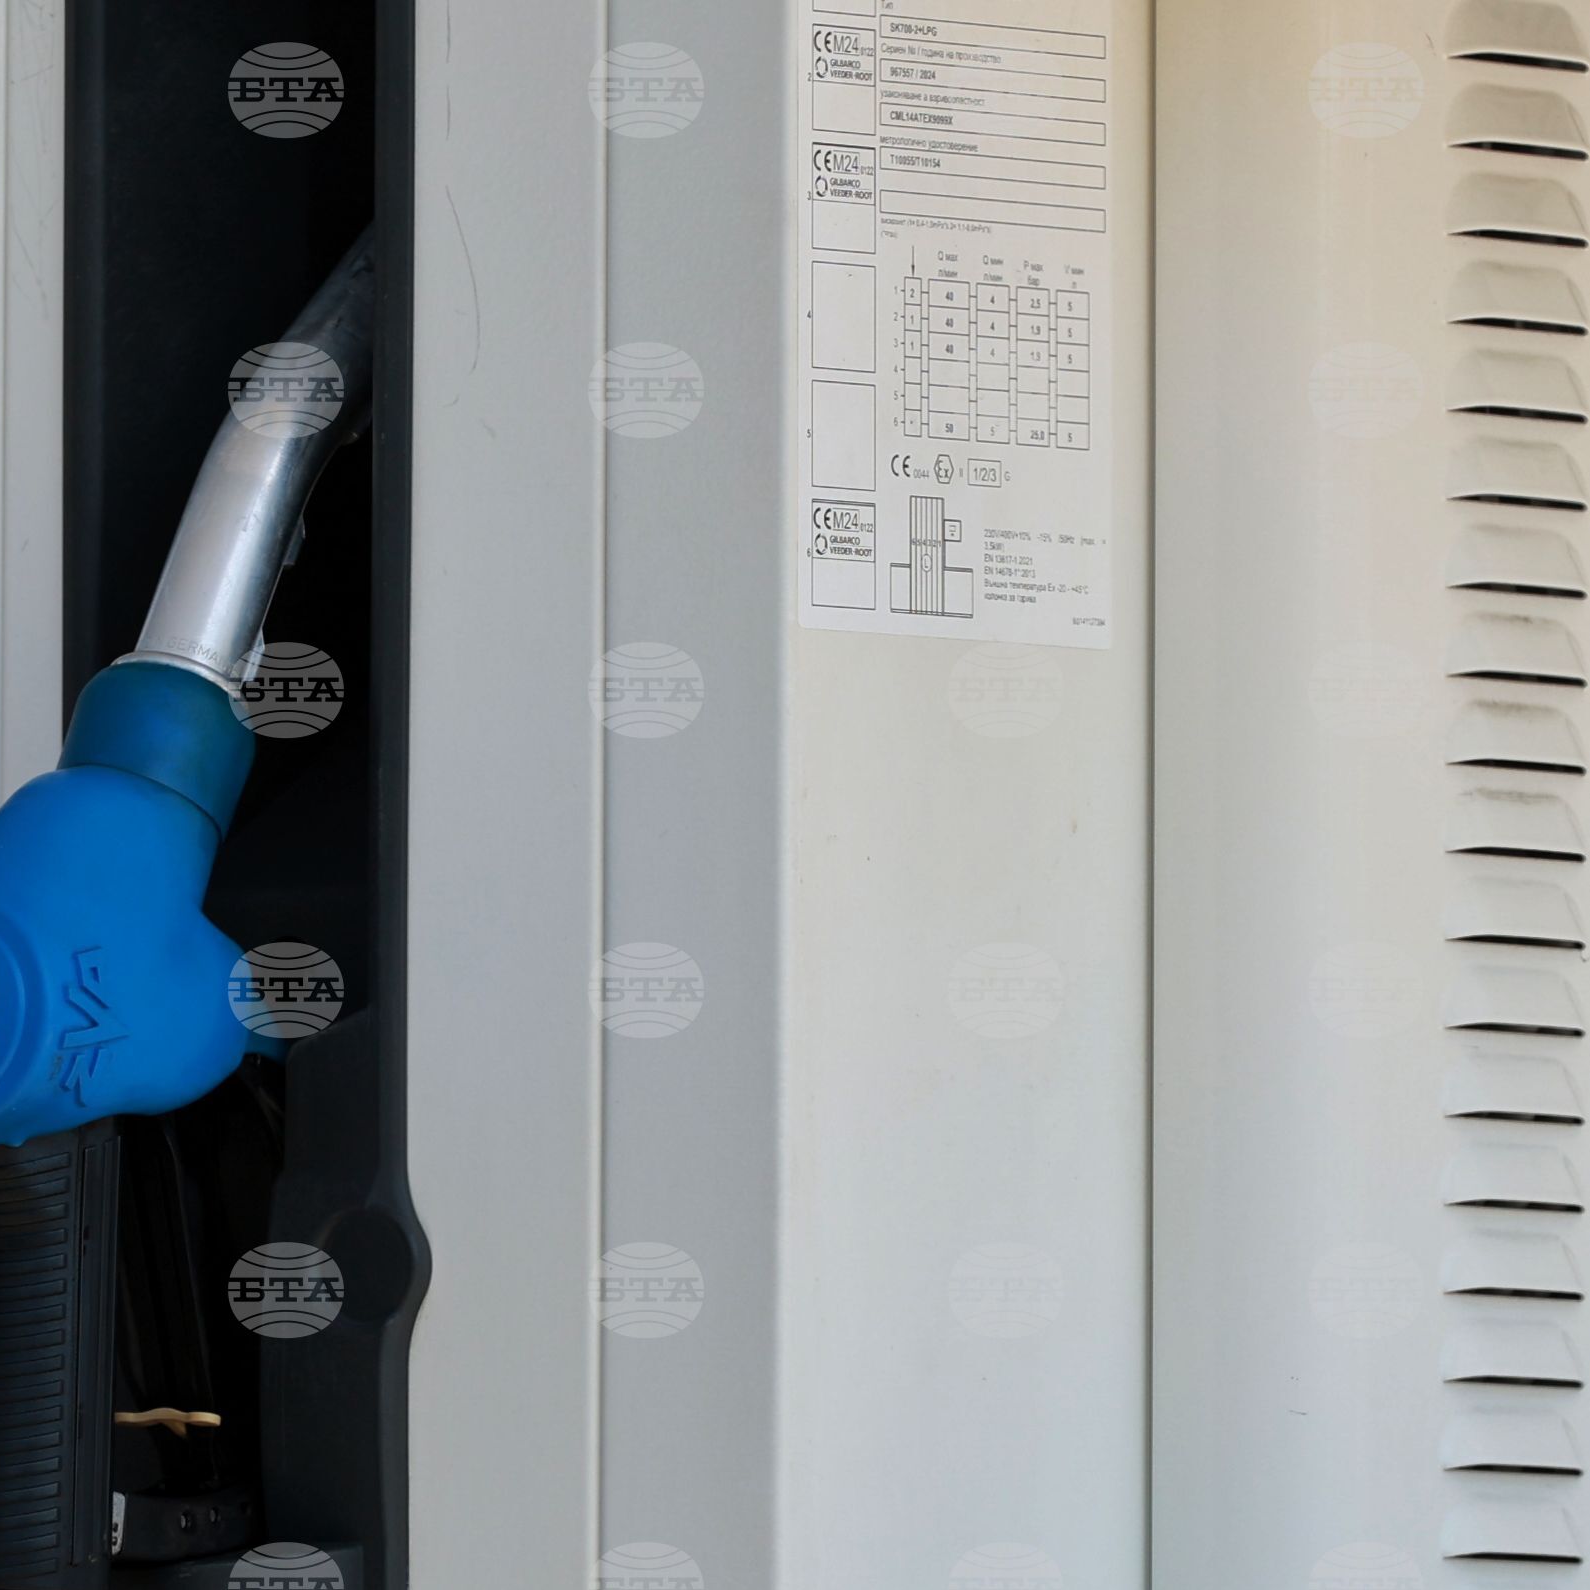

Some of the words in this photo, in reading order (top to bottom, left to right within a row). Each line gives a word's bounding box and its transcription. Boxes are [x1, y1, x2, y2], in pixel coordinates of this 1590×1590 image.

[890, 22, 938, 36] SK700-2+LPG
[833, 34, 859, 53] M24
[830, 59, 861, 69] GILBARCO
[920, 70, 936, 80] 2024
[833, 154, 859, 172] M24
[830, 177, 861, 188] GILBARCO
[910, 288, 915, 299] 2
[945, 291, 954, 302] 40
[945, 318, 954, 329] 40
[945, 344, 954, 355] 40
[945, 423, 954, 434] 50
[973, 467, 997, 482] 1/2/3
[1004, 471, 1011, 481] G
[833, 511, 858, 529] M24
[830, 535, 860, 545] GILBARCO
[984, 553, 993, 562] EN
[984, 566, 993, 575] EN
